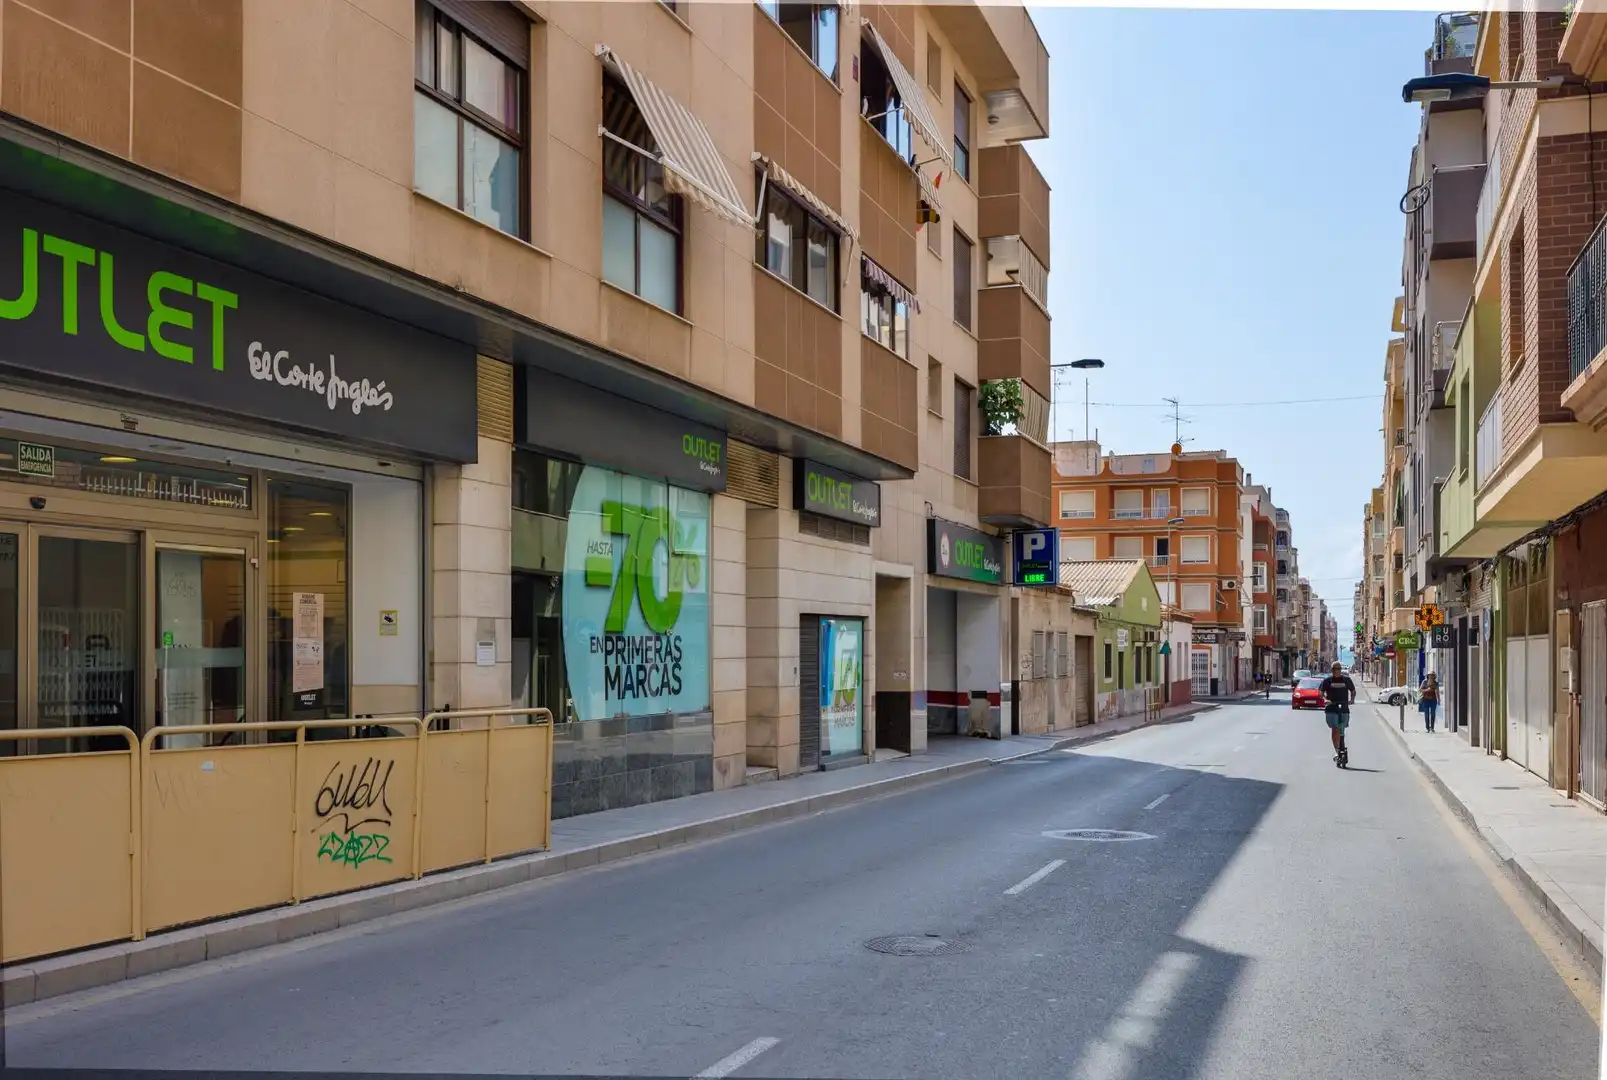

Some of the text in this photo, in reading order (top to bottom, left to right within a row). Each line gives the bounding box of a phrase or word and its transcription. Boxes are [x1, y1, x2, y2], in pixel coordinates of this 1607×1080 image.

[247, 341, 393, 415] El Corte Inglés
[20, 445, 52, 462] SALIDA
[682, 434, 721, 462] OUTLET
[20, 460, 52, 473] EMERGENCIA
[808, 472, 851, 510] OUTLET
[586, 540, 613, 556] HASTA
[955, 539, 985, 569] OUTLET
[1023, 533, 1046, 560] P
[1024, 573, 1045, 583] LIBRE
[590, 635, 683, 665] EN PRIMERAS
[604, 662, 683, 701] MARCAS
